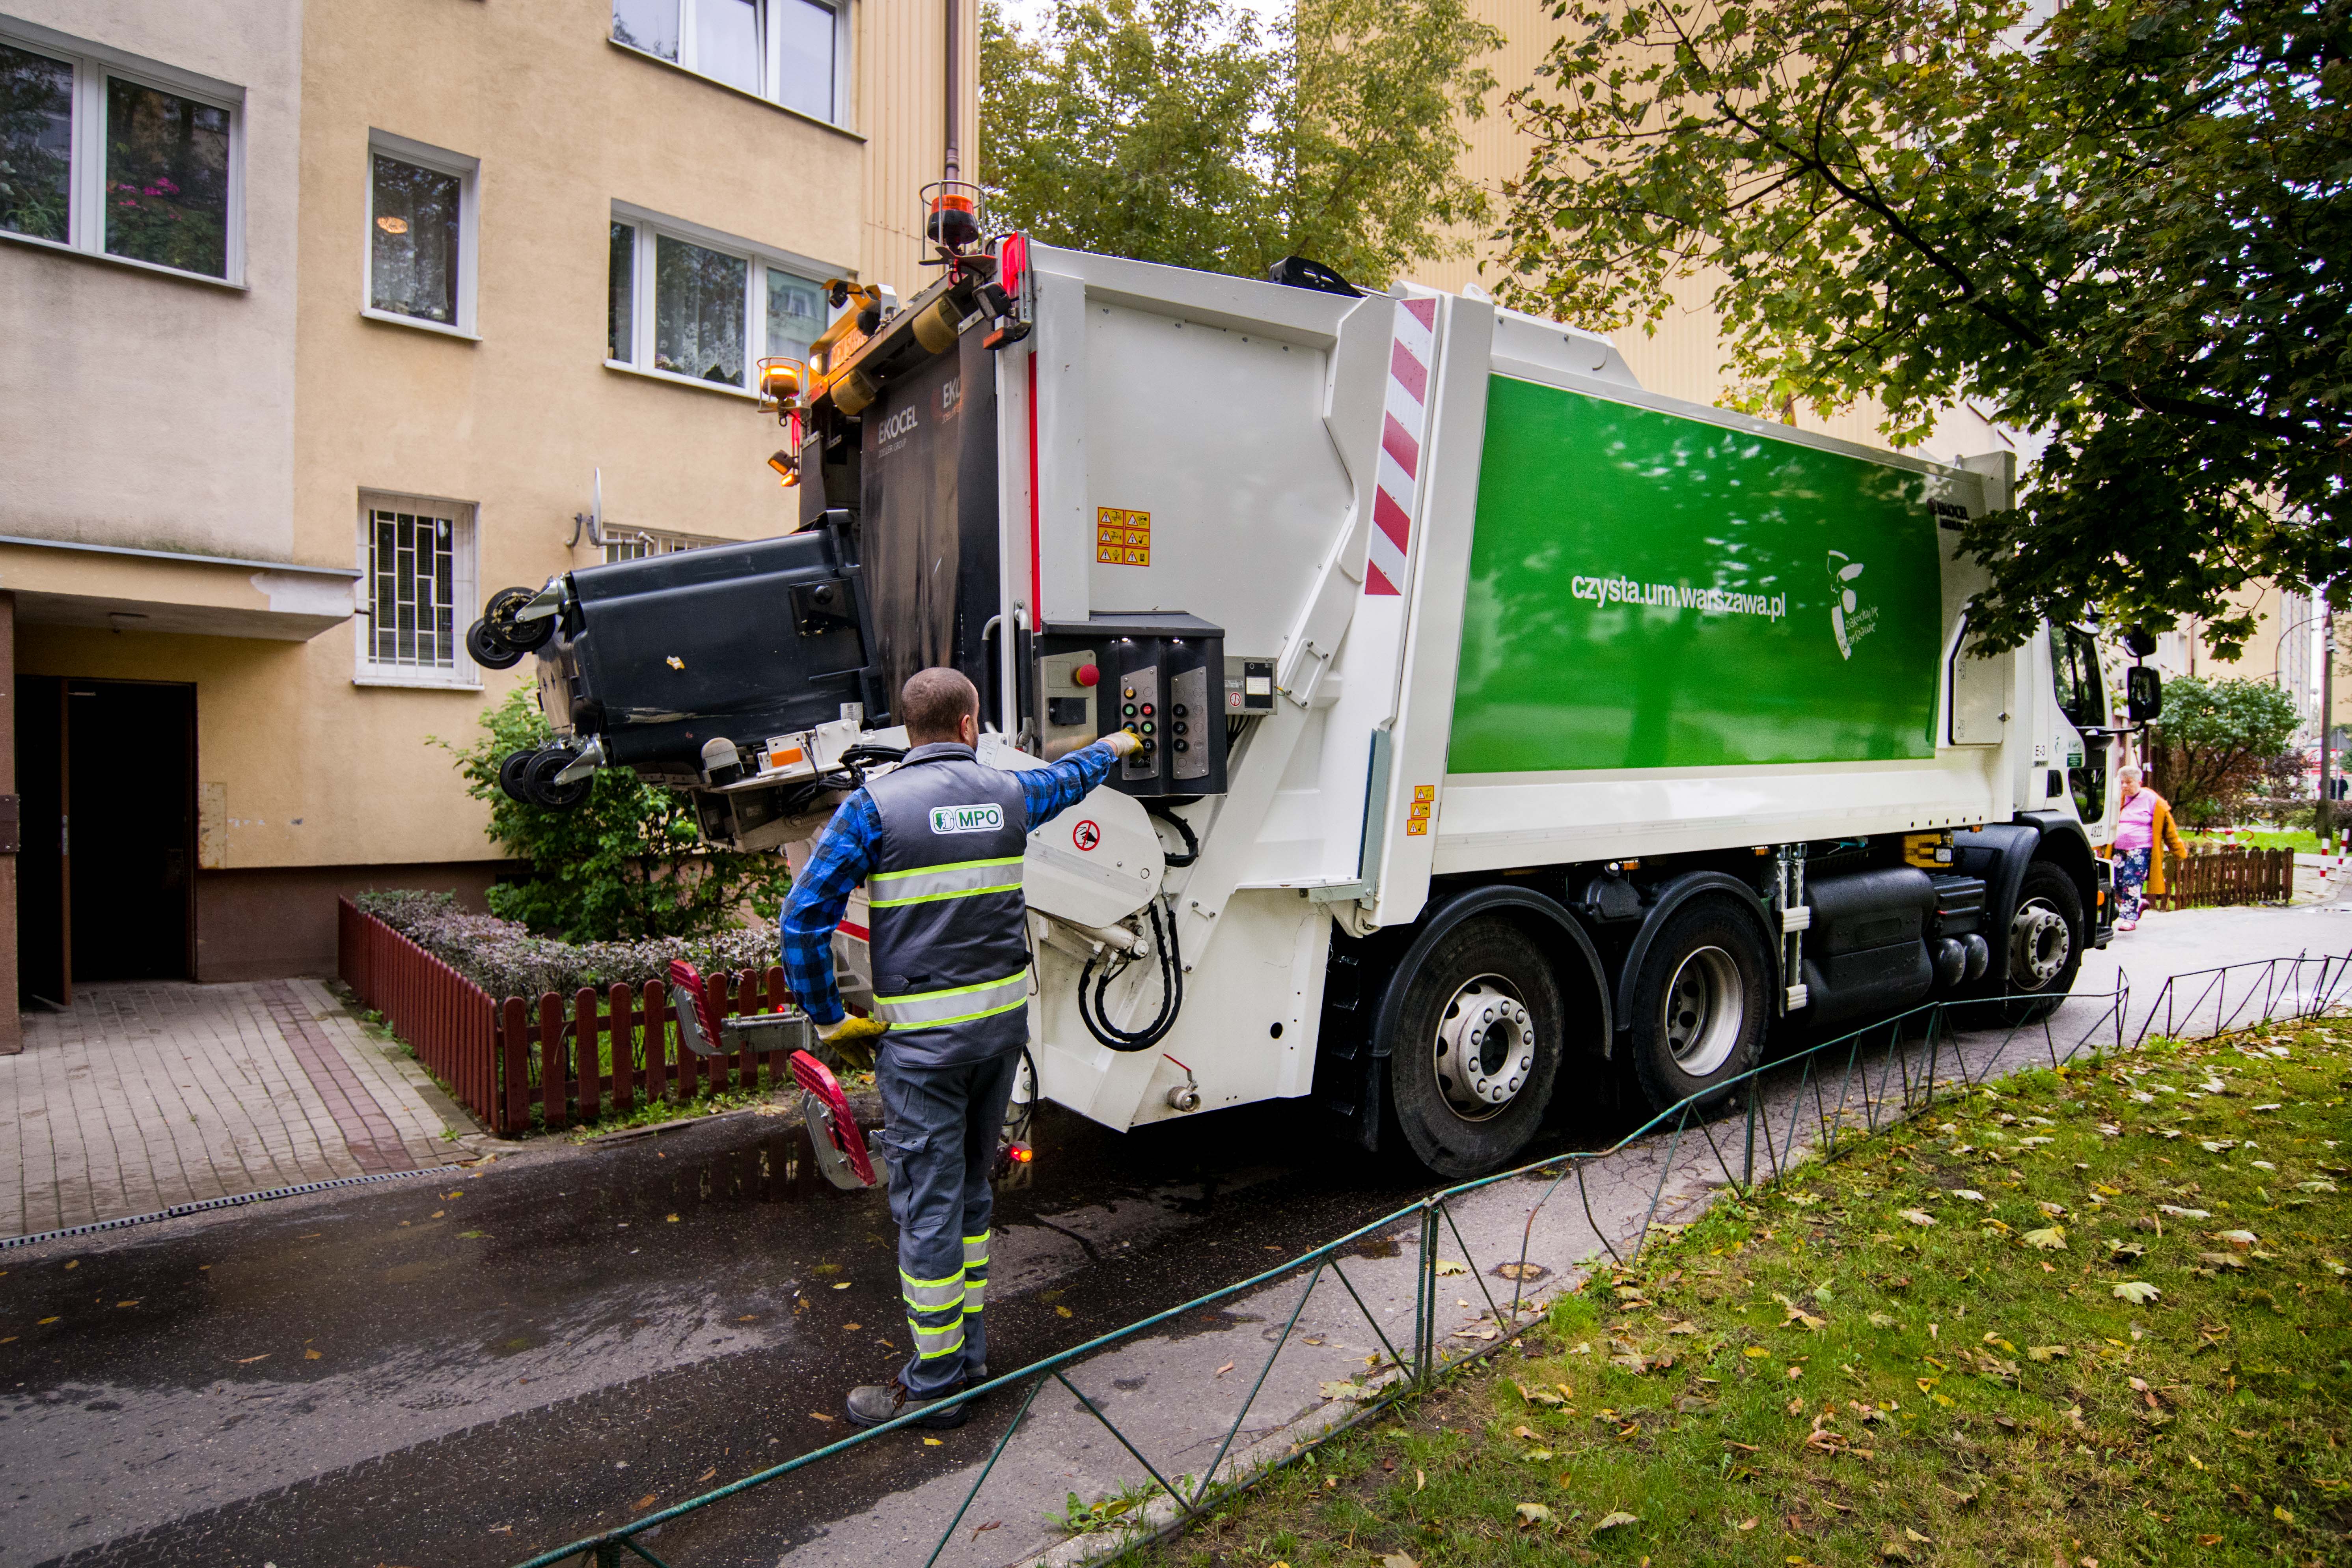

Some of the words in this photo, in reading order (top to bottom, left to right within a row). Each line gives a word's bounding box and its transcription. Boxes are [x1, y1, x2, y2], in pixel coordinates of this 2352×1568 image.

[878, 405, 918, 444] EKOCEL
[878, 444, 893, 459] ZOELLER
[894, 438, 907, 451] GROUP
[1937, 501, 1970, 520] EKOCEL
[1571, 575, 1786, 623] czysta.um.warszawa.pl
[2035, 745, 2045, 756] E-3
[958, 810, 999, 827] MPO
[2091, 825, 2102, 837] 4822
